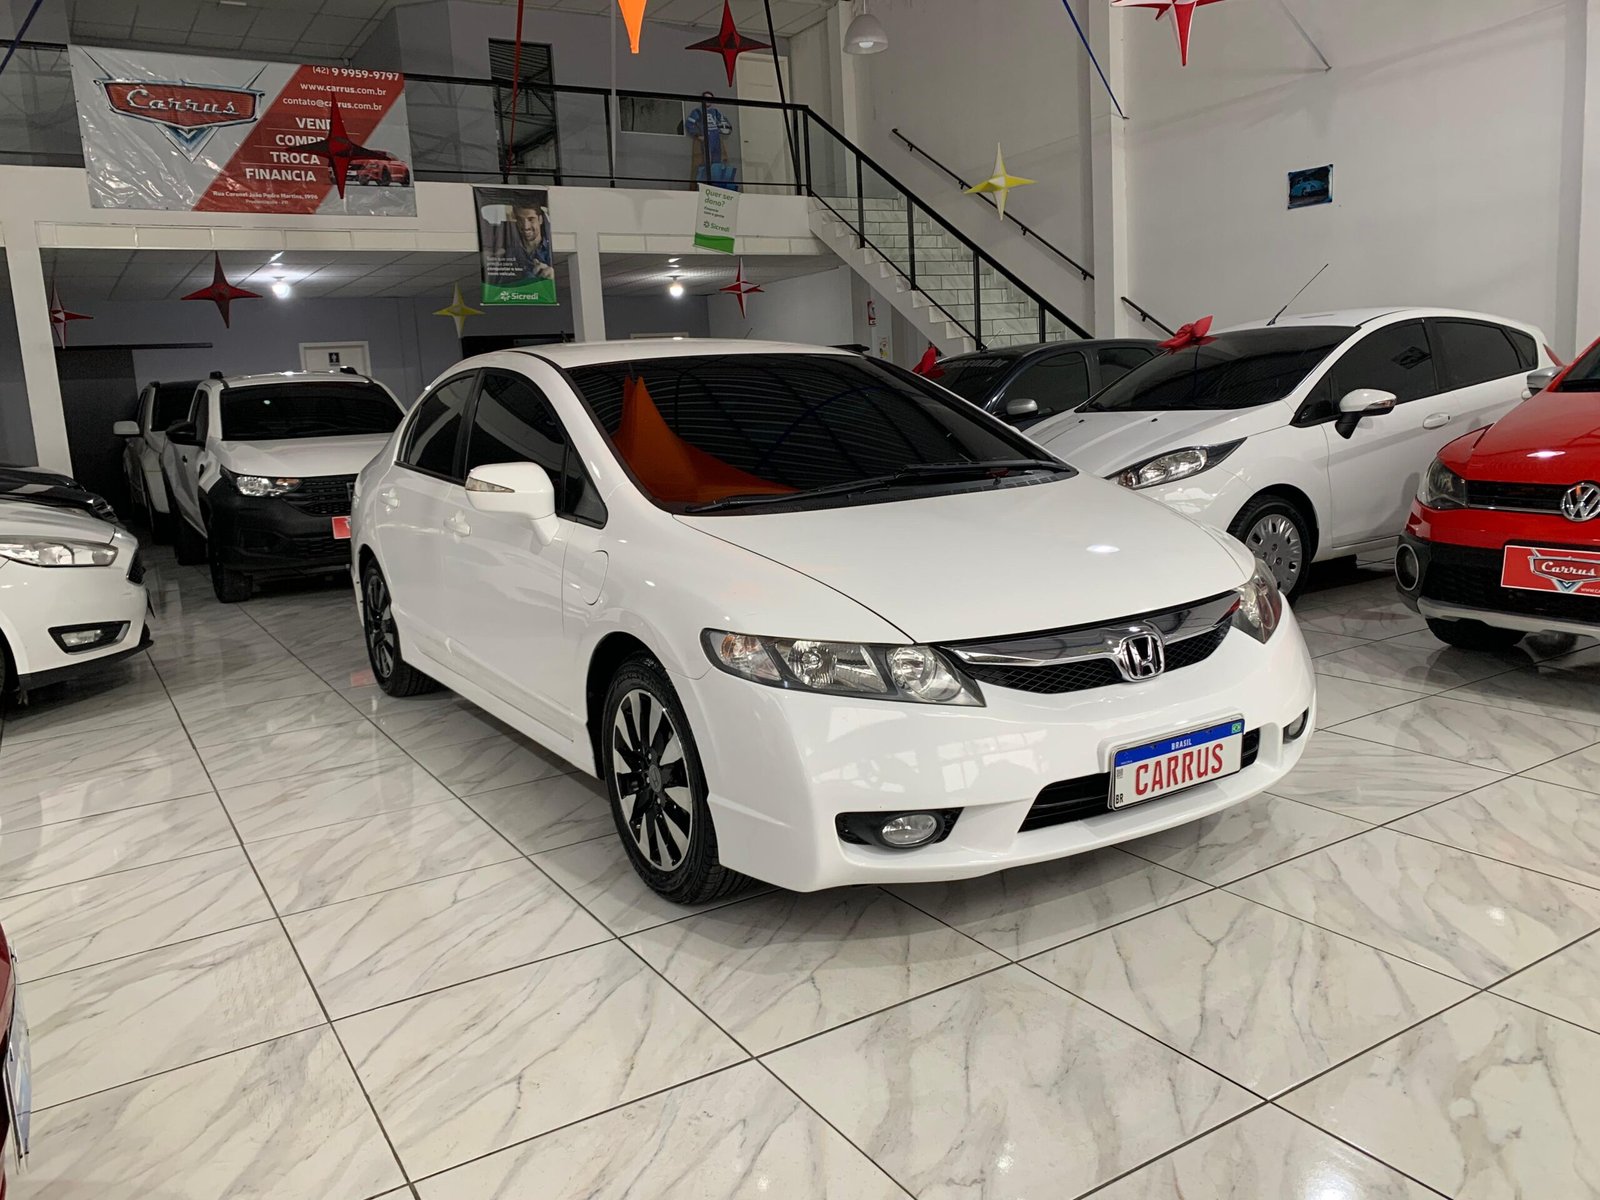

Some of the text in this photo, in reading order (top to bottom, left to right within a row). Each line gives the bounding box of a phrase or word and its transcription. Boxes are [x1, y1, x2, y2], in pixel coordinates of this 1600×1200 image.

[340, 68, 399, 81] 9959-9797
[300, 83, 387, 96] www.carrus.com.br
[126, 88, 240, 115] Carrus
[283, 97, 383, 111] contato@carus.com.br
[269, 151, 321, 165] TROCA
[245, 168, 317, 182] FINANCIA
[705, 188, 722, 198] Quer
[704, 197, 726, 208] dono?
[710, 222, 730, 233] Sicredi
[511, 291, 539, 300] Sicredi
[1541, 561, 1597, 576] Carrus
[1171, 738, 1192, 750] BRASIL
[1135, 743, 1224, 796] CARRUS
